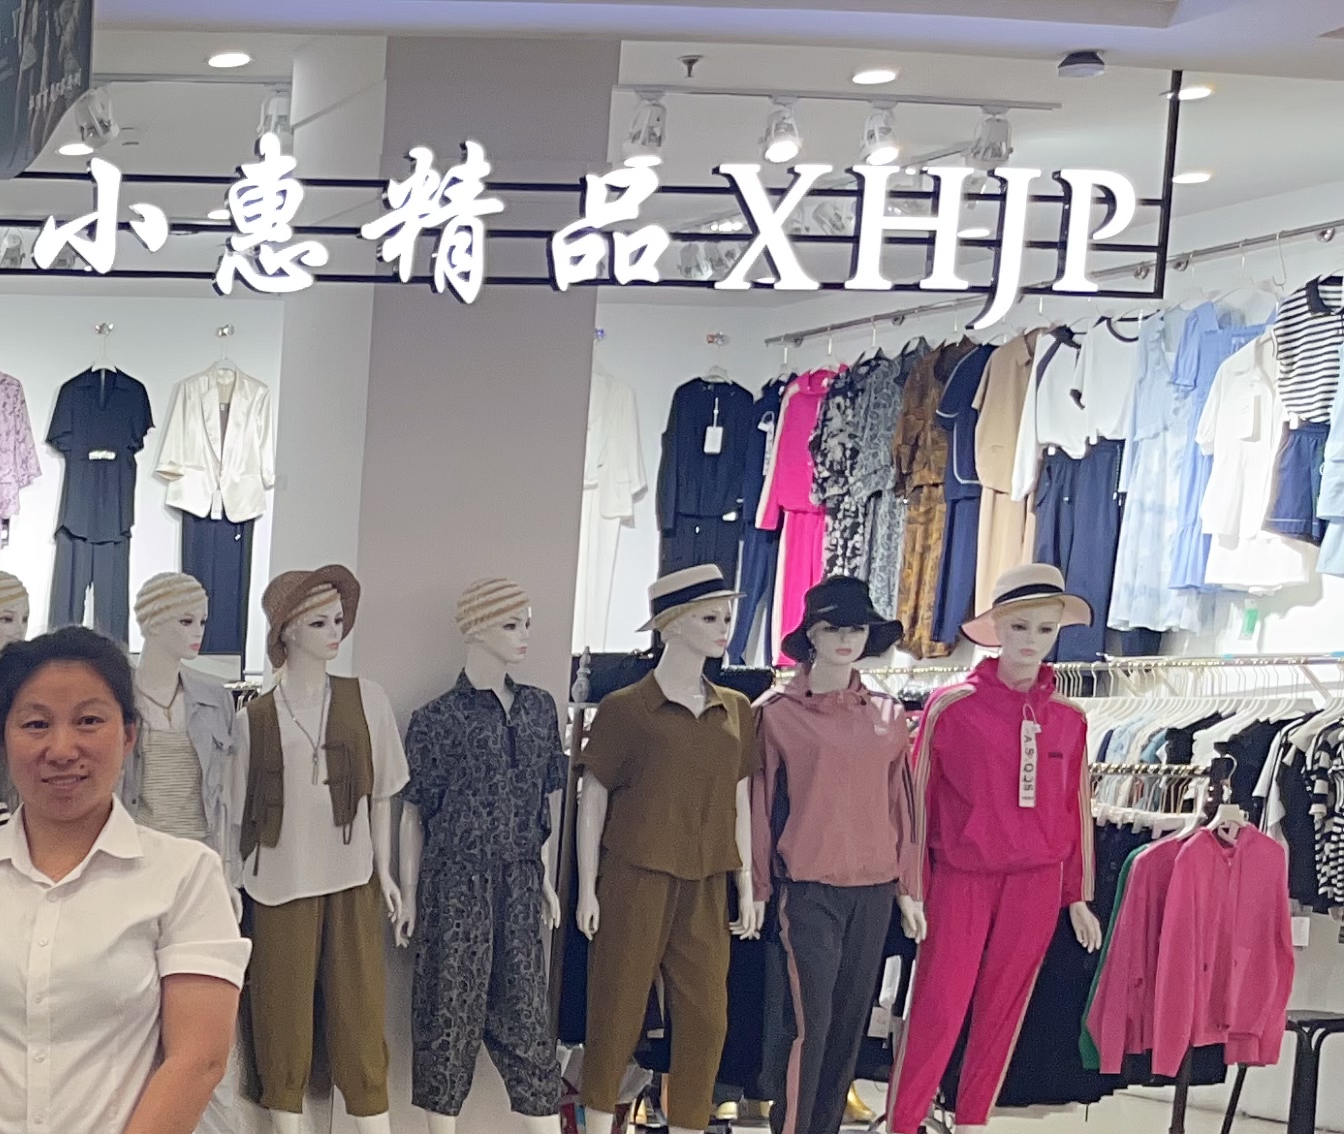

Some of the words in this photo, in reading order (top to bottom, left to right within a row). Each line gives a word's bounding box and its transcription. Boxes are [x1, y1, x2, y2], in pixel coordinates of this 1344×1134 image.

[33, 133, 670, 304] 小惠精品
[713, 163, 1137, 330] XHJP
